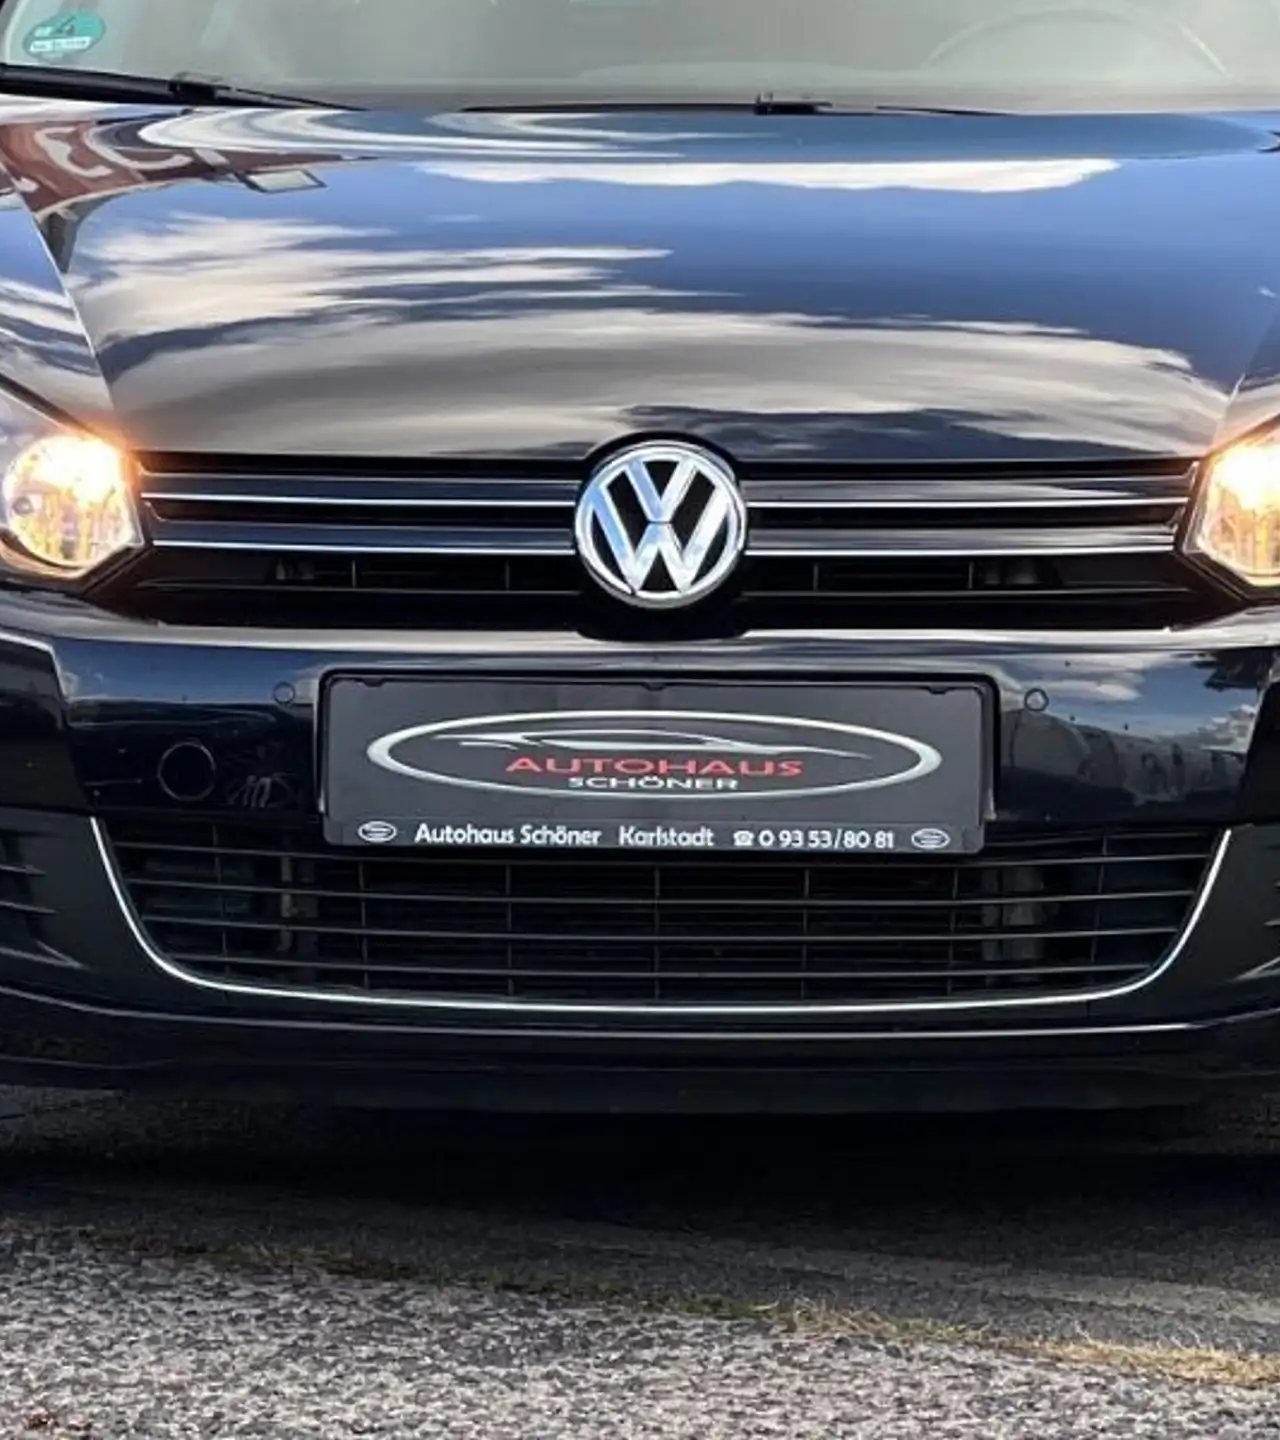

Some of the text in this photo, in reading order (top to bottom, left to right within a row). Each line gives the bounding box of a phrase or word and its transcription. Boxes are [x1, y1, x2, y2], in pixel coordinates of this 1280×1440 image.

[584, 446, 738, 601] VW
[506, 757, 804, 776] AUTOHAUS
[568, 775, 739, 790] SCHÖNER
[415, 823, 516, 846] Autohaus
[520, 824, 602, 846] Schöner
[619, 826, 715, 847] Karlstadt
[778, 830, 803, 847] 93
[808, 829, 871, 849] 53/80
[874, 831, 894, 848] 81
